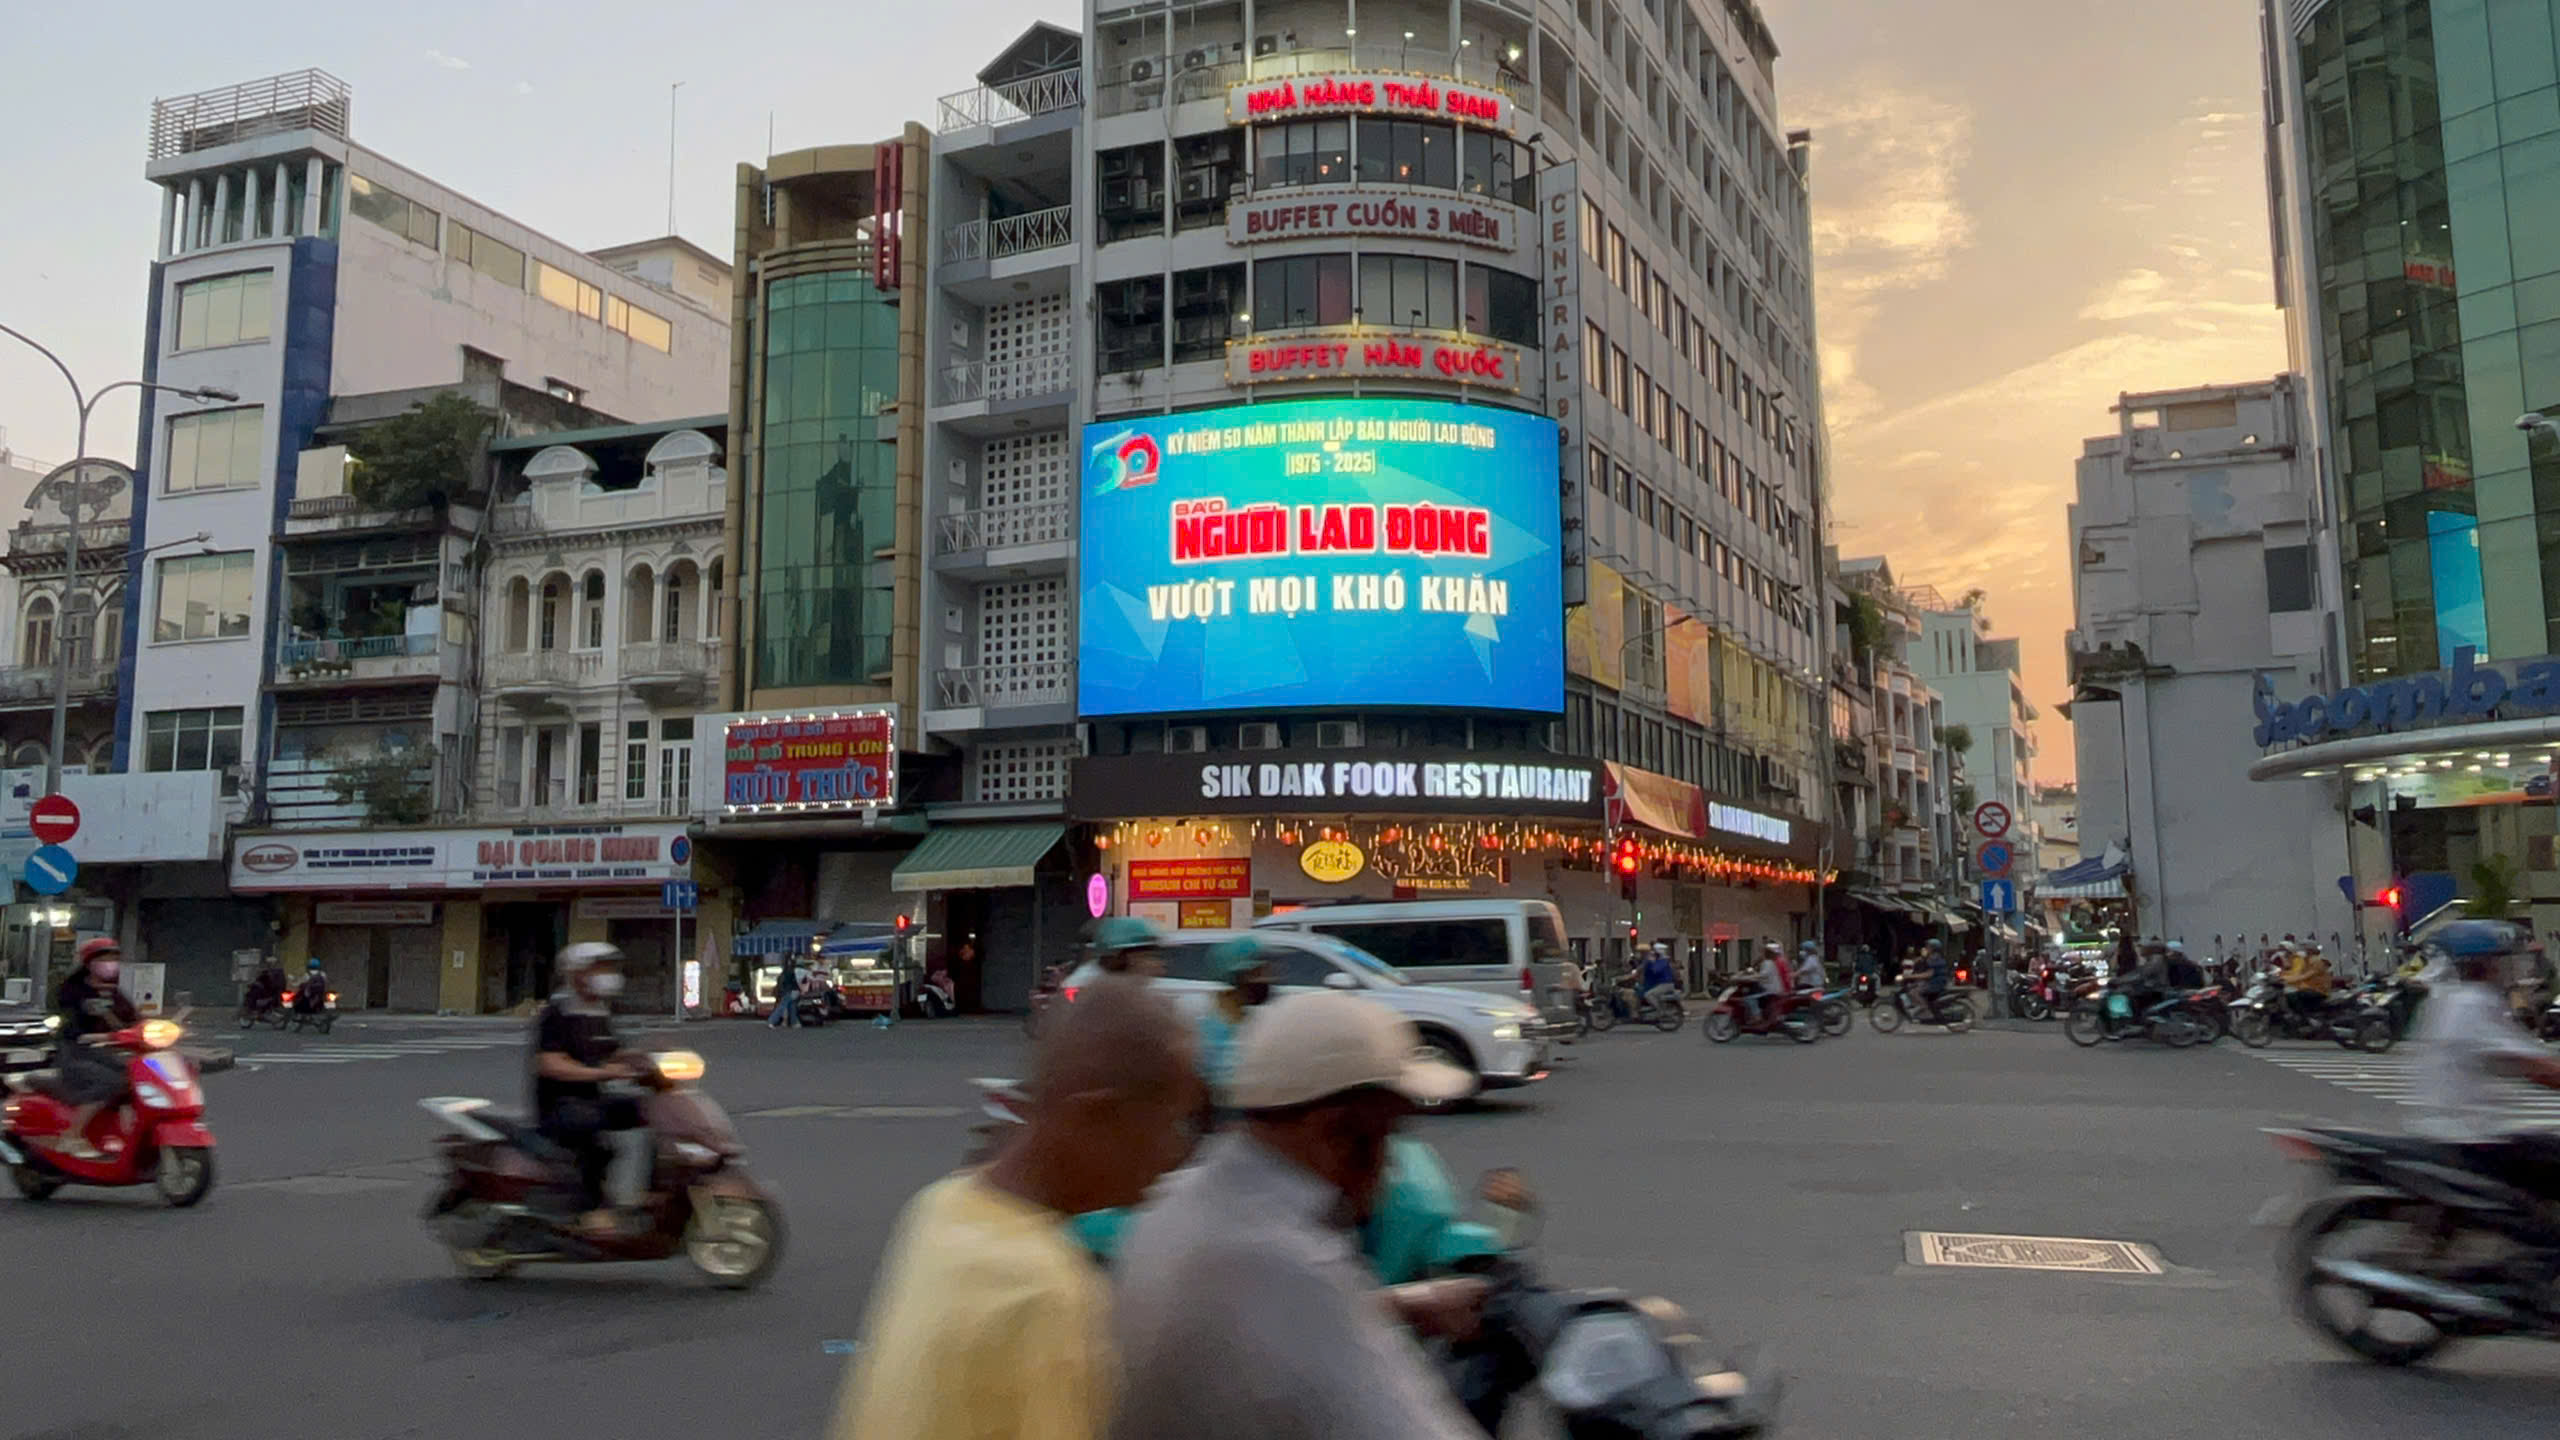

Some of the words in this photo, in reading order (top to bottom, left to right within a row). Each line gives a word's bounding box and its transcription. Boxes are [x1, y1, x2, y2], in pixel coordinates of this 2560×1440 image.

[1247, 80, 1297, 115] NHÀ
[1304, 77, 1376, 106] HÀNG
[1384, 80, 1440, 111] THÁI
[1446, 89, 1500, 121] SIAM
[1247, 203, 1338, 235] BUFFET
[1347, 198, 1416, 229] CUỐN
[1427, 208, 1440, 231] 3
[1450, 209, 1499, 240] MIỀN
[1551, 193, 1569, 382] CENTRAL
[1249, 344, 1348, 373] BUFFET
[1364, 336, 1422, 368] HÀN
[1434, 345, 1504, 379] QUỐC
[1224, 427, 1241, 448] 50
[1435, 423, 1458, 444] LAO
[1175, 499, 1223, 516] BÁO
[1176, 505, 1288, 560] NGƯỜI
[1300, 506, 1374, 552] LAO
[1386, 503, 1488, 555] ĐỘNG
[1148, 576, 1235, 624] VƯỢT
[1250, 575, 1317, 619] MỌI
[1333, 569, 1404, 610] KHÓ
[1421, 572, 1508, 615] KHĂN
[1201, 765, 1252, 798] SIK
[1259, 763, 1326, 796] DAK
[1333, 762, 1418, 797] FOOK
[1424, 762, 1592, 802] RESTAURANT
[519, 837, 596, 867] QUANG
